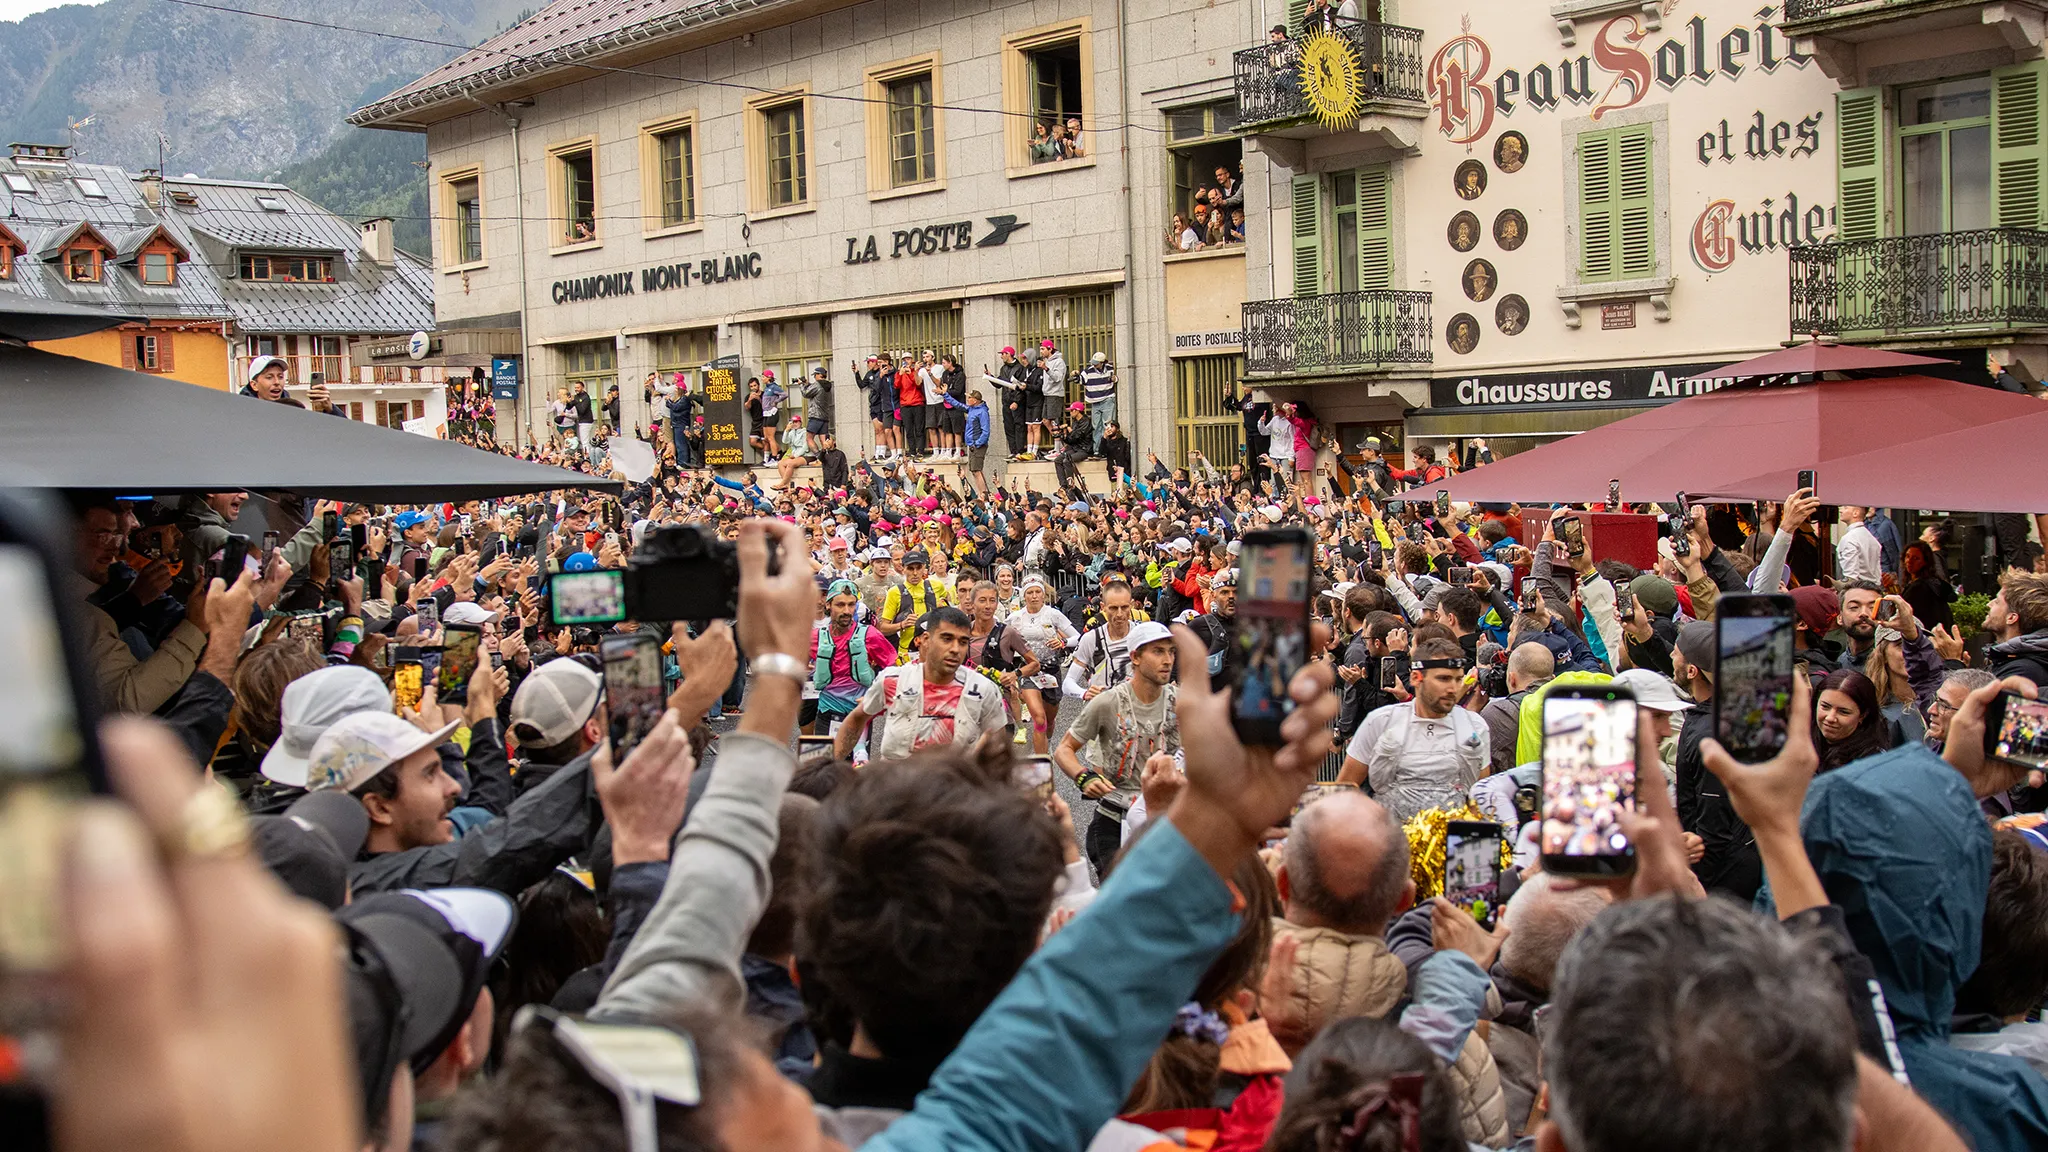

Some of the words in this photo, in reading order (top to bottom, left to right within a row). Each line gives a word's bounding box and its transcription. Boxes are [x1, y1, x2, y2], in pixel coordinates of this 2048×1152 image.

[1696, 118, 1736, 166] et
[1744, 110, 1823, 160] des
[844, 235, 881, 264] LA
[890, 220, 973, 259] POSTE
[552, 271, 635, 305] CHAMONIX
[642, 252, 762, 292] MONT-BLANC
[1176, 335, 1201, 347] BOITES
[1205, 331, 1243, 345] POSTALES
[371, 347, 382, 355] LA
[385, 344, 410, 354] POSTE
[705, 384, 737, 394] CITOYENNE
[1456, 378, 1612, 405] Chaussures
[711, 424, 719, 433] 15
[720, 424, 735, 433] août
[712, 432, 721, 440] 30
[705, 455, 743, 465] chamonix.fr
